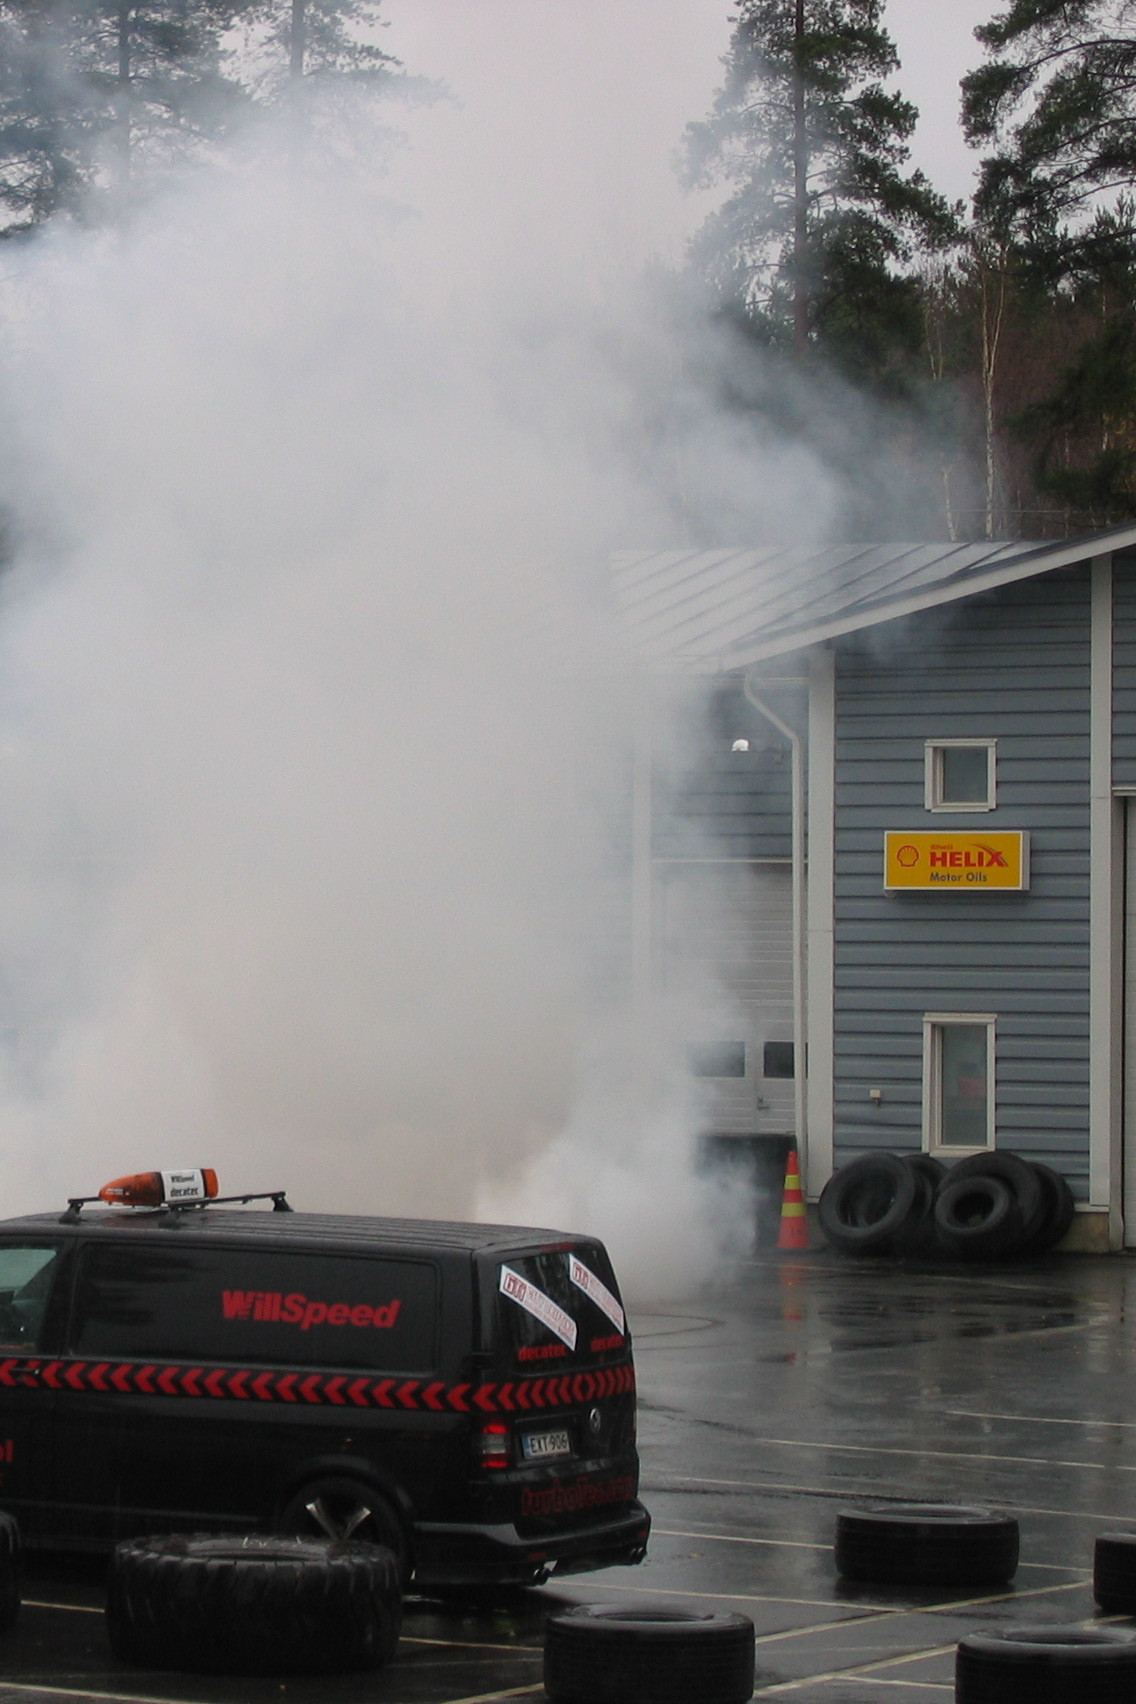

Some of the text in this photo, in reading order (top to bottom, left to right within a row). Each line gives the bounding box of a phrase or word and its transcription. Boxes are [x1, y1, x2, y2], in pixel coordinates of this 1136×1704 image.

[930, 846, 1009, 867] HELIX
[930, 871, 988, 882] Motor Oils
[170, 1187, 199, 1198] decatec
[221, 1290, 402, 1331] WillSpeed
